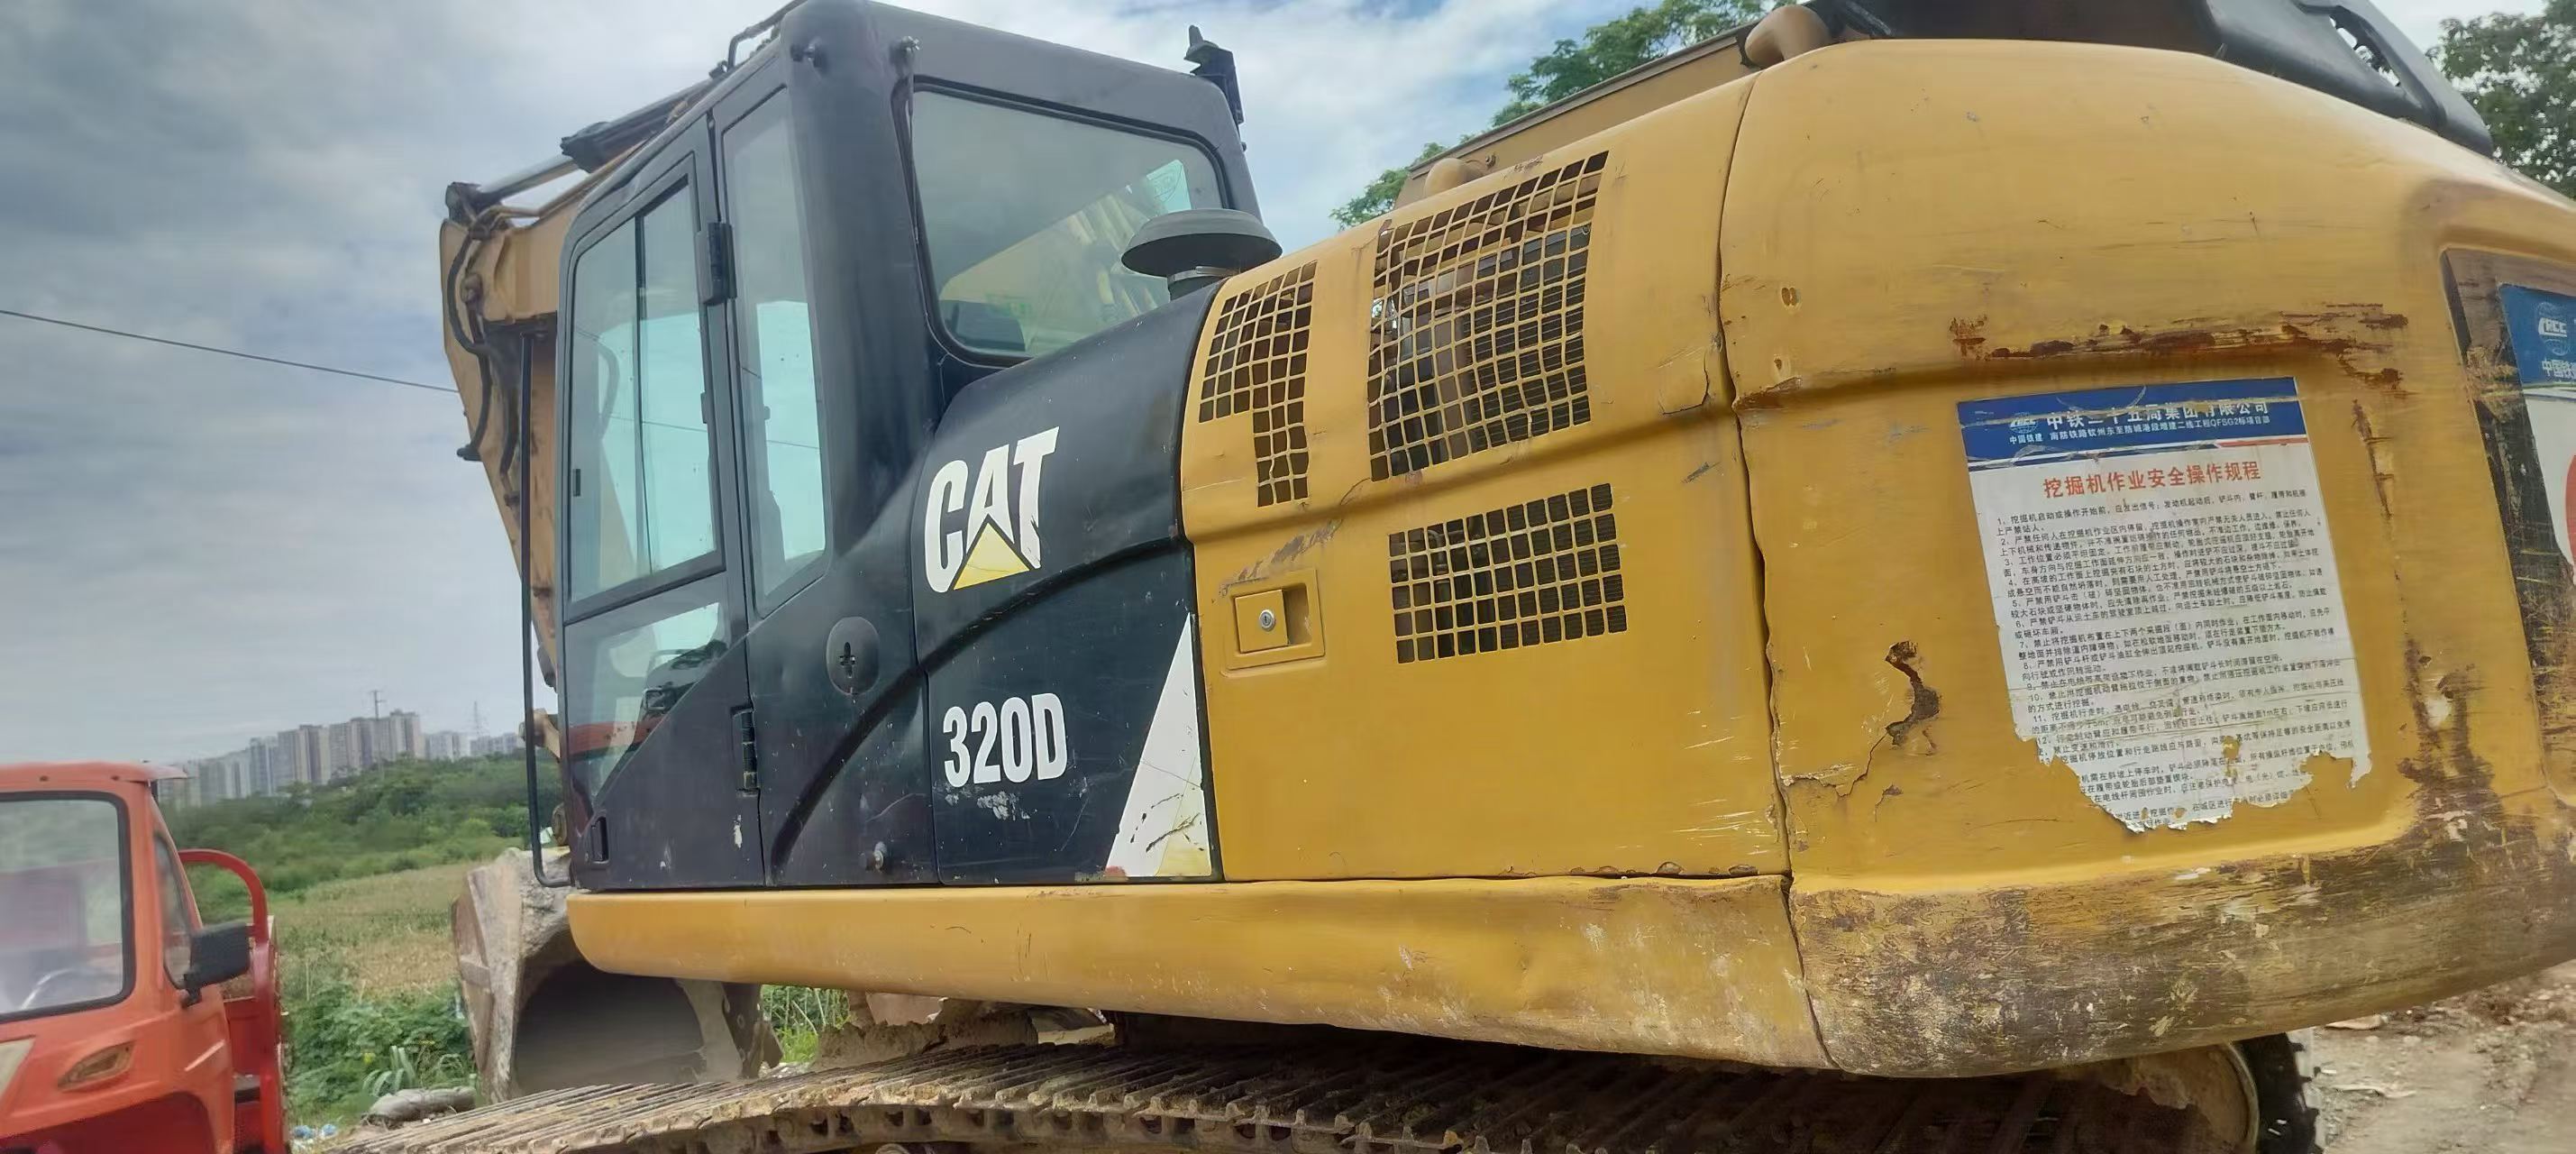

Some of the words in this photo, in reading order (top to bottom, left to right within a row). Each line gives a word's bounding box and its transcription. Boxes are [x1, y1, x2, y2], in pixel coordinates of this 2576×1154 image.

[2009, 433, 2043, 444] 中国铁建
[925, 426, 1060, 592] CAT
[2043, 460, 2261, 499] 挖掘机作业安全操作规程
[943, 692, 1068, 788] 320D
